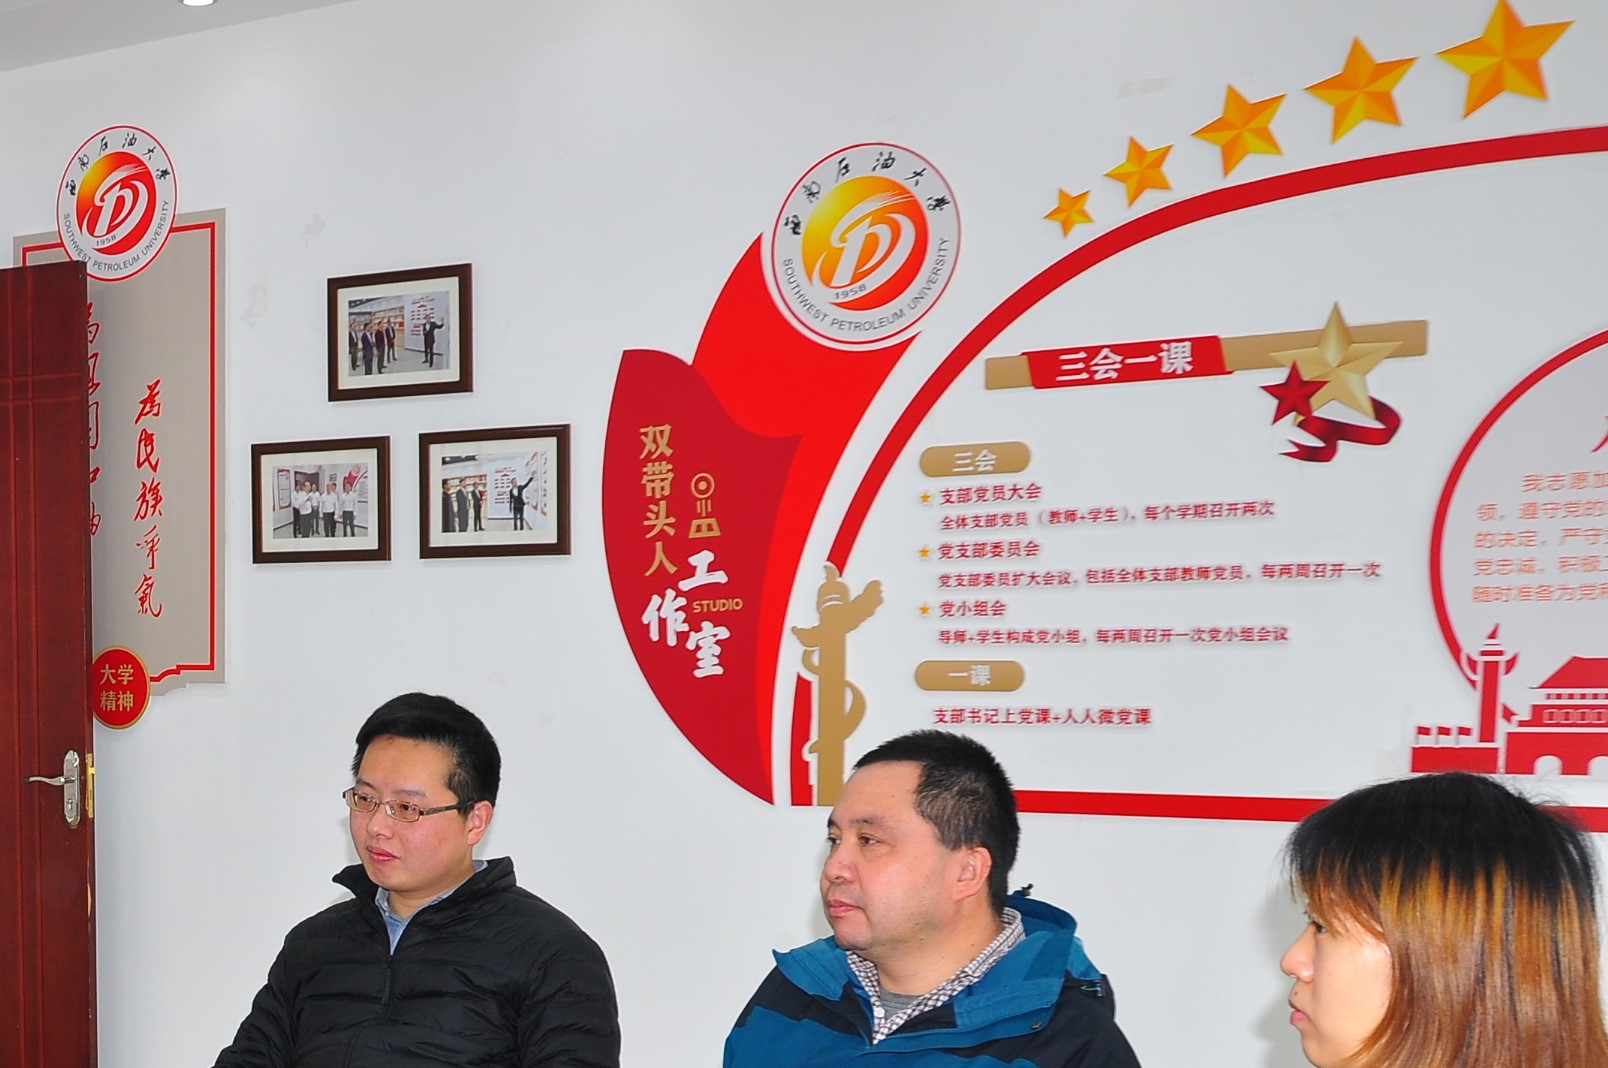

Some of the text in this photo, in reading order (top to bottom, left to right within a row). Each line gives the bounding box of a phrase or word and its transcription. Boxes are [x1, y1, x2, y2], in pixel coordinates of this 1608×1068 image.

[92, 254, 141, 272] PETROLEUM
[142, 200, 169, 256] UNIVERSITY
[782, 237, 950, 332] SOUTHWEST PETROLEUM UNIVERSITY
[1054, 341, 1194, 383] 三会一课
[952, 449, 997, 474] 三会
[639, 423, 679, 576] 双带头人
[939, 482, 1042, 506] 支部党员大会
[938, 540, 1041, 560] 党支部委员会
[692, 598, 743, 614] STUDIO
[939, 600, 1007, 618] 党小组会
[100, 663, 134, 685] 大学
[948, 664, 992, 686] 一课
[100, 690, 134, 711] 精神
